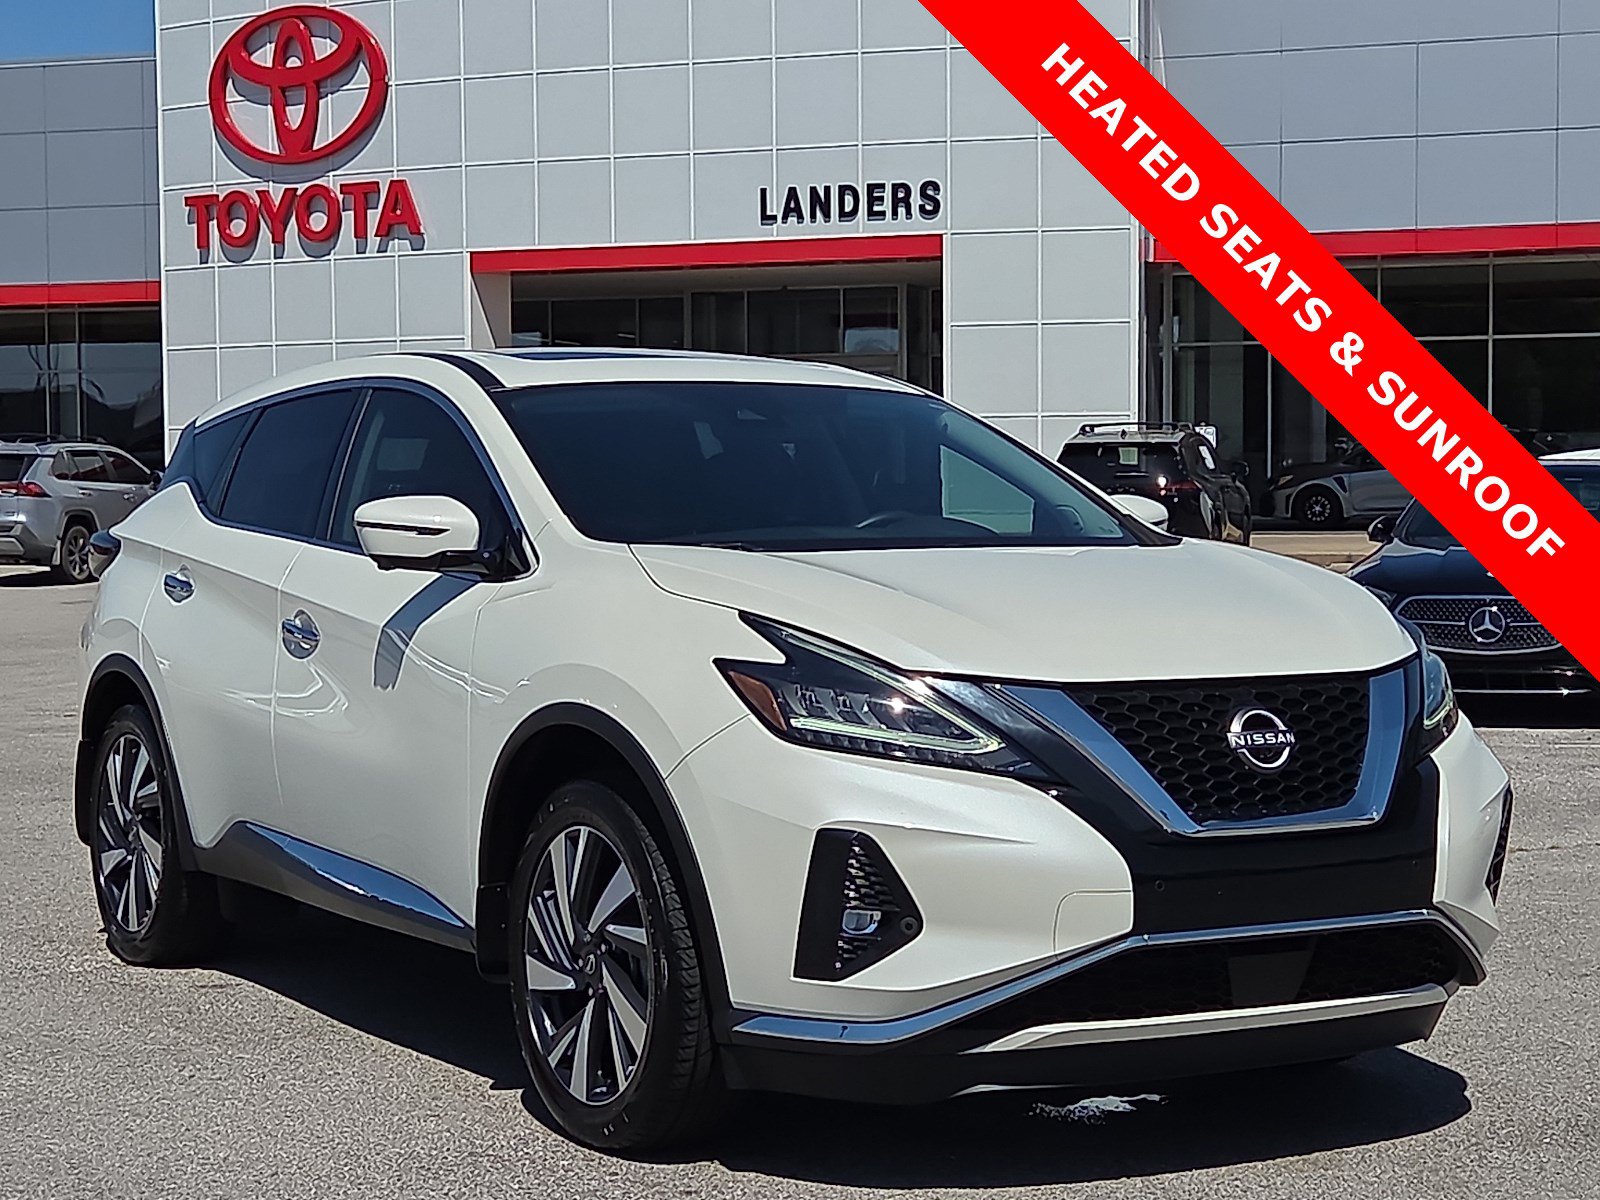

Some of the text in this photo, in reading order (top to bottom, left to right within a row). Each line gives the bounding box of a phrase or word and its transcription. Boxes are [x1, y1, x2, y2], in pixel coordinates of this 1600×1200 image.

[184, 179, 424, 250] TOYOTA
[759, 179, 942, 226] LANDERS
[1229, 732, 1296, 747] NISSAN
